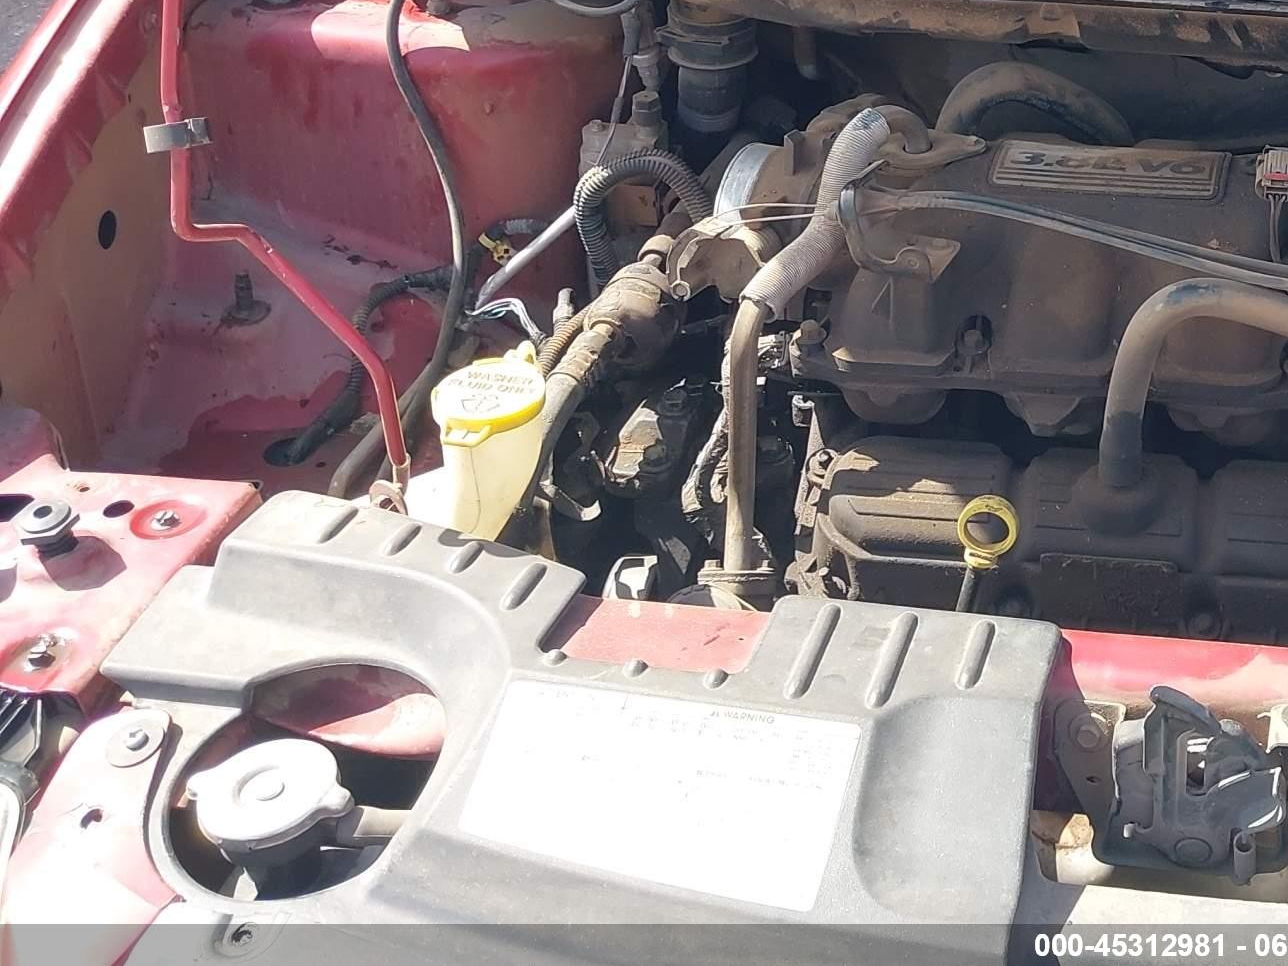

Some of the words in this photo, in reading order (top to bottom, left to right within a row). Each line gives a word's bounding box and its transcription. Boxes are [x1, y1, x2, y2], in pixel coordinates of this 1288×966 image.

[1138, 159, 1207, 175] V6
[467, 370, 533, 385] WASHER
[724, 710, 775, 725] WARNING
